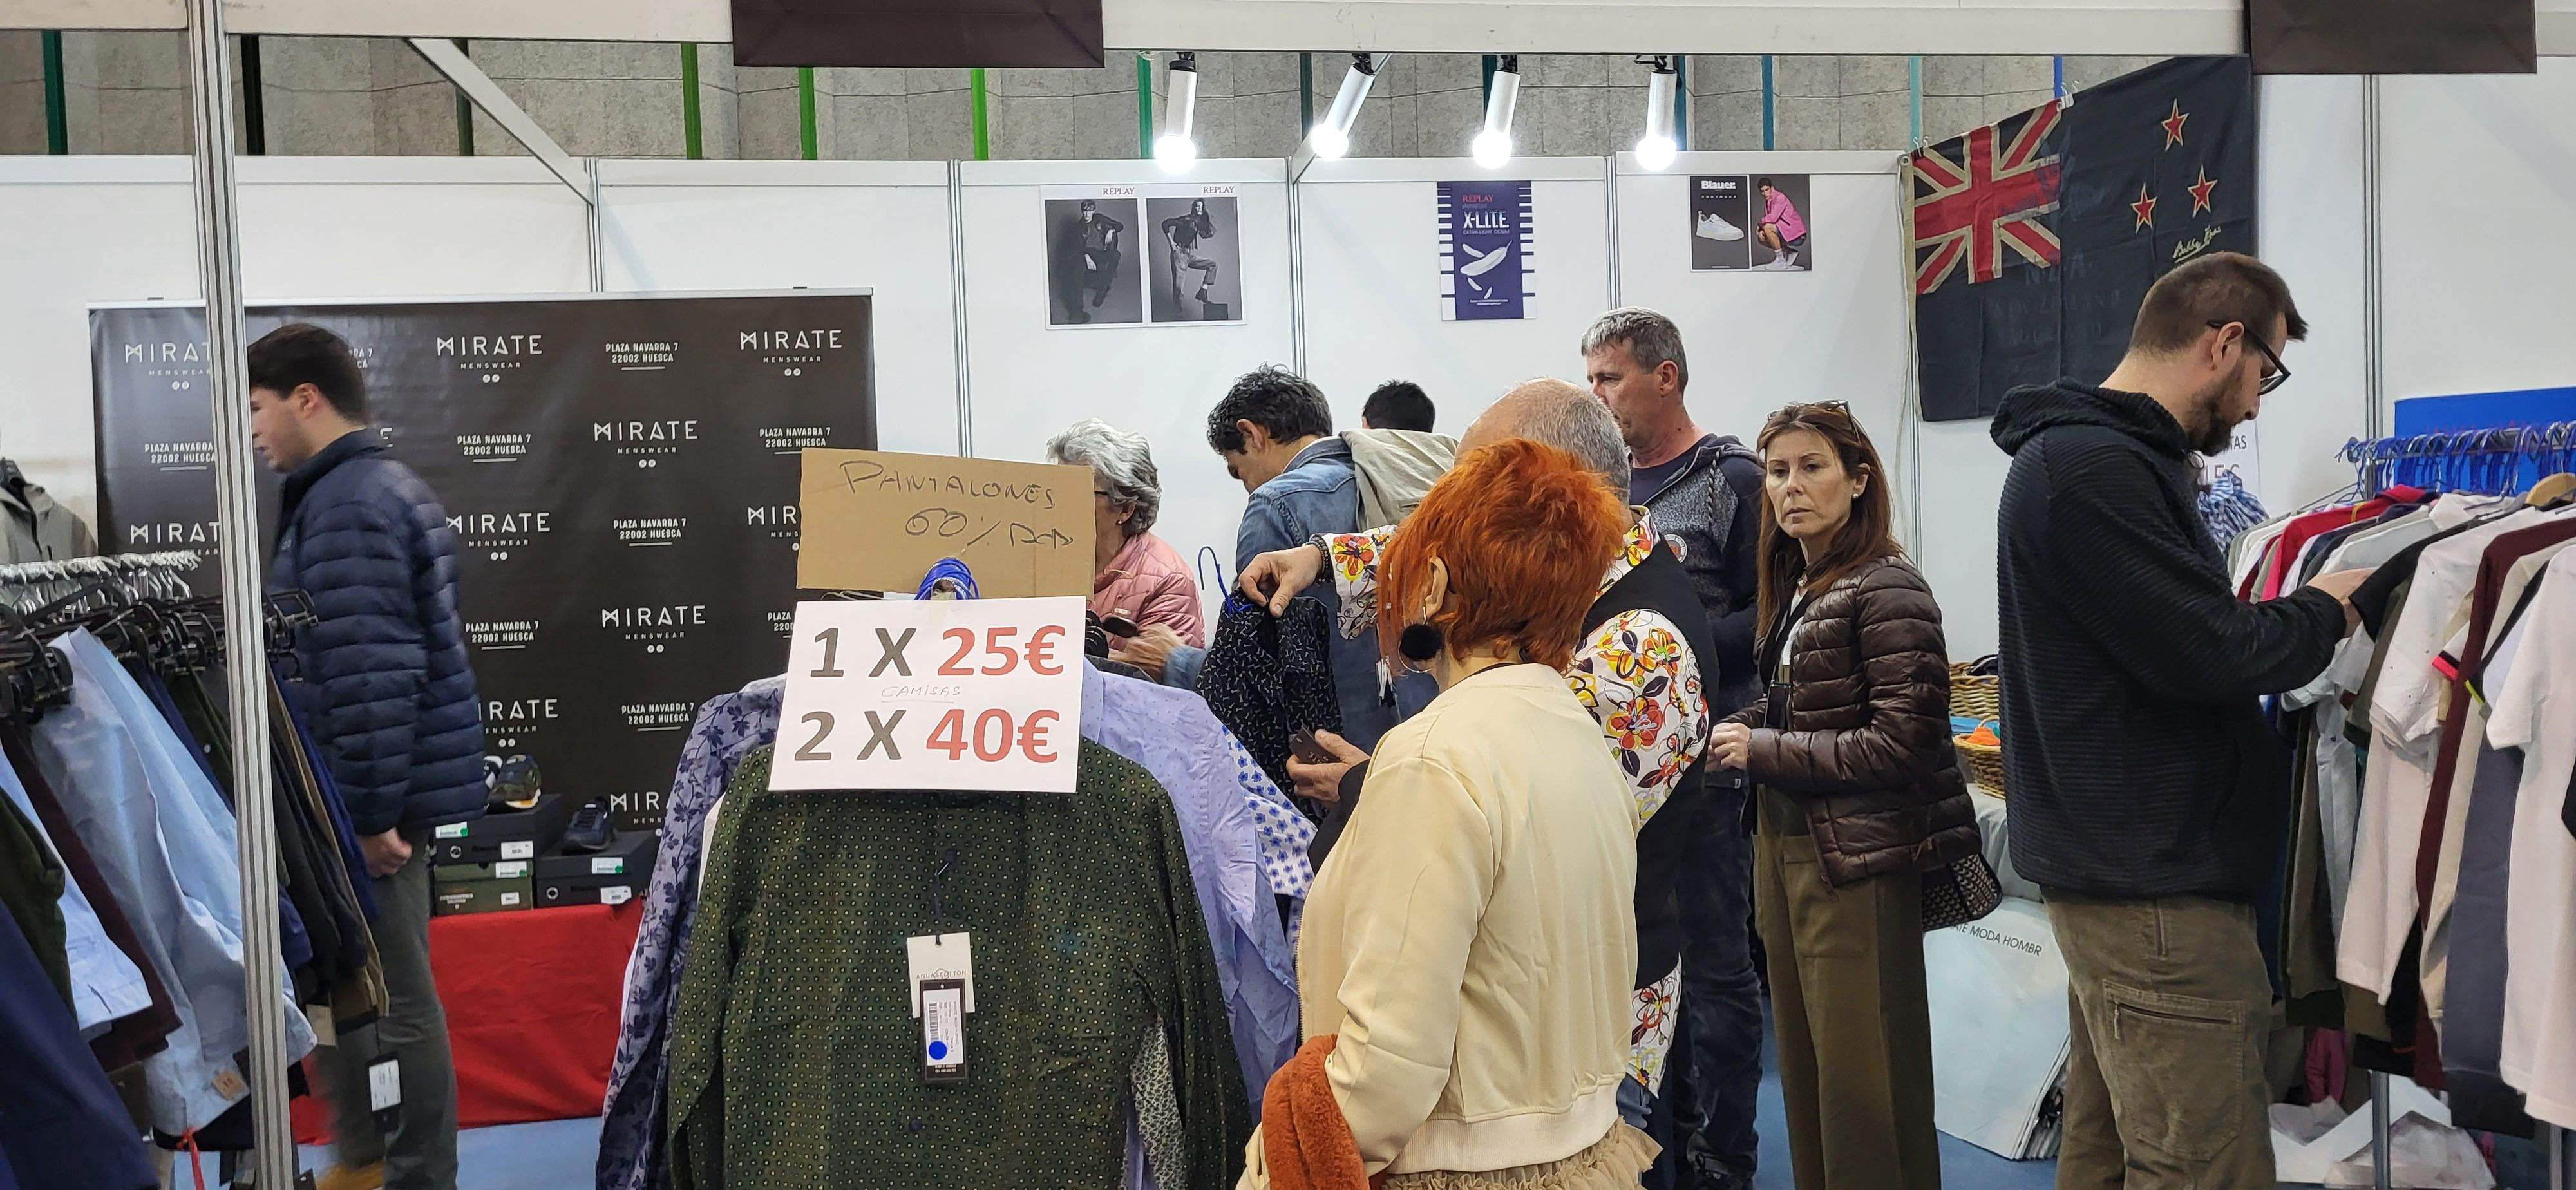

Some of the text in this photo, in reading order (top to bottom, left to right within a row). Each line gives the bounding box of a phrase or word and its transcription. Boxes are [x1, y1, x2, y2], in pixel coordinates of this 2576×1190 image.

[1462, 194, 1493, 203] REPLAY
[1463, 210, 1510, 229] X-LITE
[436, 334, 543, 356] MIRATE
[740, 329, 842, 350] MIRATE
[605, 342, 679, 353] PLAZA NAVARRA 7
[612, 353, 674, 364] 22002 HUESCA
[594, 420, 698, 442] MIRATE
[759, 427, 831, 437] PLAZA NAVARRA 7
[457, 433, 531, 444] PLAZA NAVARRA 7
[765, 438, 826, 448] 22002 HUESCA
[144, 442, 214, 453] PLAZA NAVARRA
[463, 444, 526, 455] 22002 HUESCA
[151, 453, 180, 464] 22002
[839, 460, 1056, 509] PANTALONES
[445, 512, 551, 534] MIRATE
[613, 518, 687, 529] PLAZA NAVARRA 7
[620, 529, 681, 540] 22002 HUESCA
[601, 605, 706, 628] MIRATE
[767, 612, 791, 621] PLAZA
[466, 620, 539, 632] PLAZA NAVARRA 7
[471, 632, 535, 643] 22002 HUESCA
[810, 625, 1066, 677] 1 X 25€
[621, 702, 694, 715] PLAZA NAVARRA 7
[628, 713, 690, 725] 22002 HUESCA
[794, 708, 1061, 764] 2 X 40€
[1969, 925, 2000, 943] MODA
